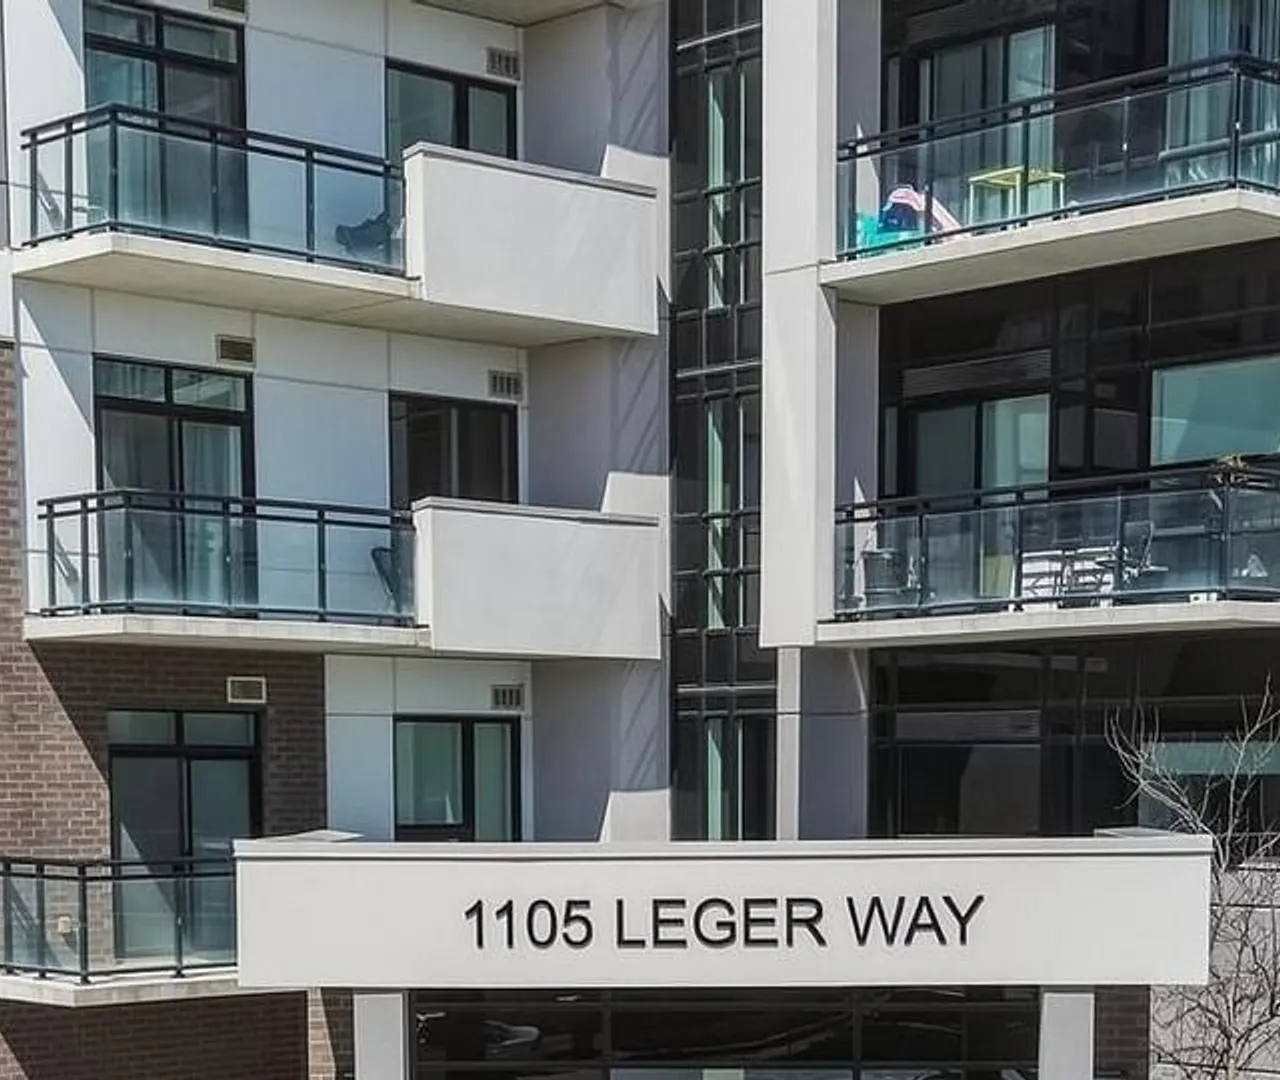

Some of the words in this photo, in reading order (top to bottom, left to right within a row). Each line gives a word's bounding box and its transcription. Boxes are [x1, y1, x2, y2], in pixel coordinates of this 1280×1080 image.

[464, 899, 593, 948] 1105
[616, 897, 827, 948] LEGER
[846, 895, 984, 946] WAY
